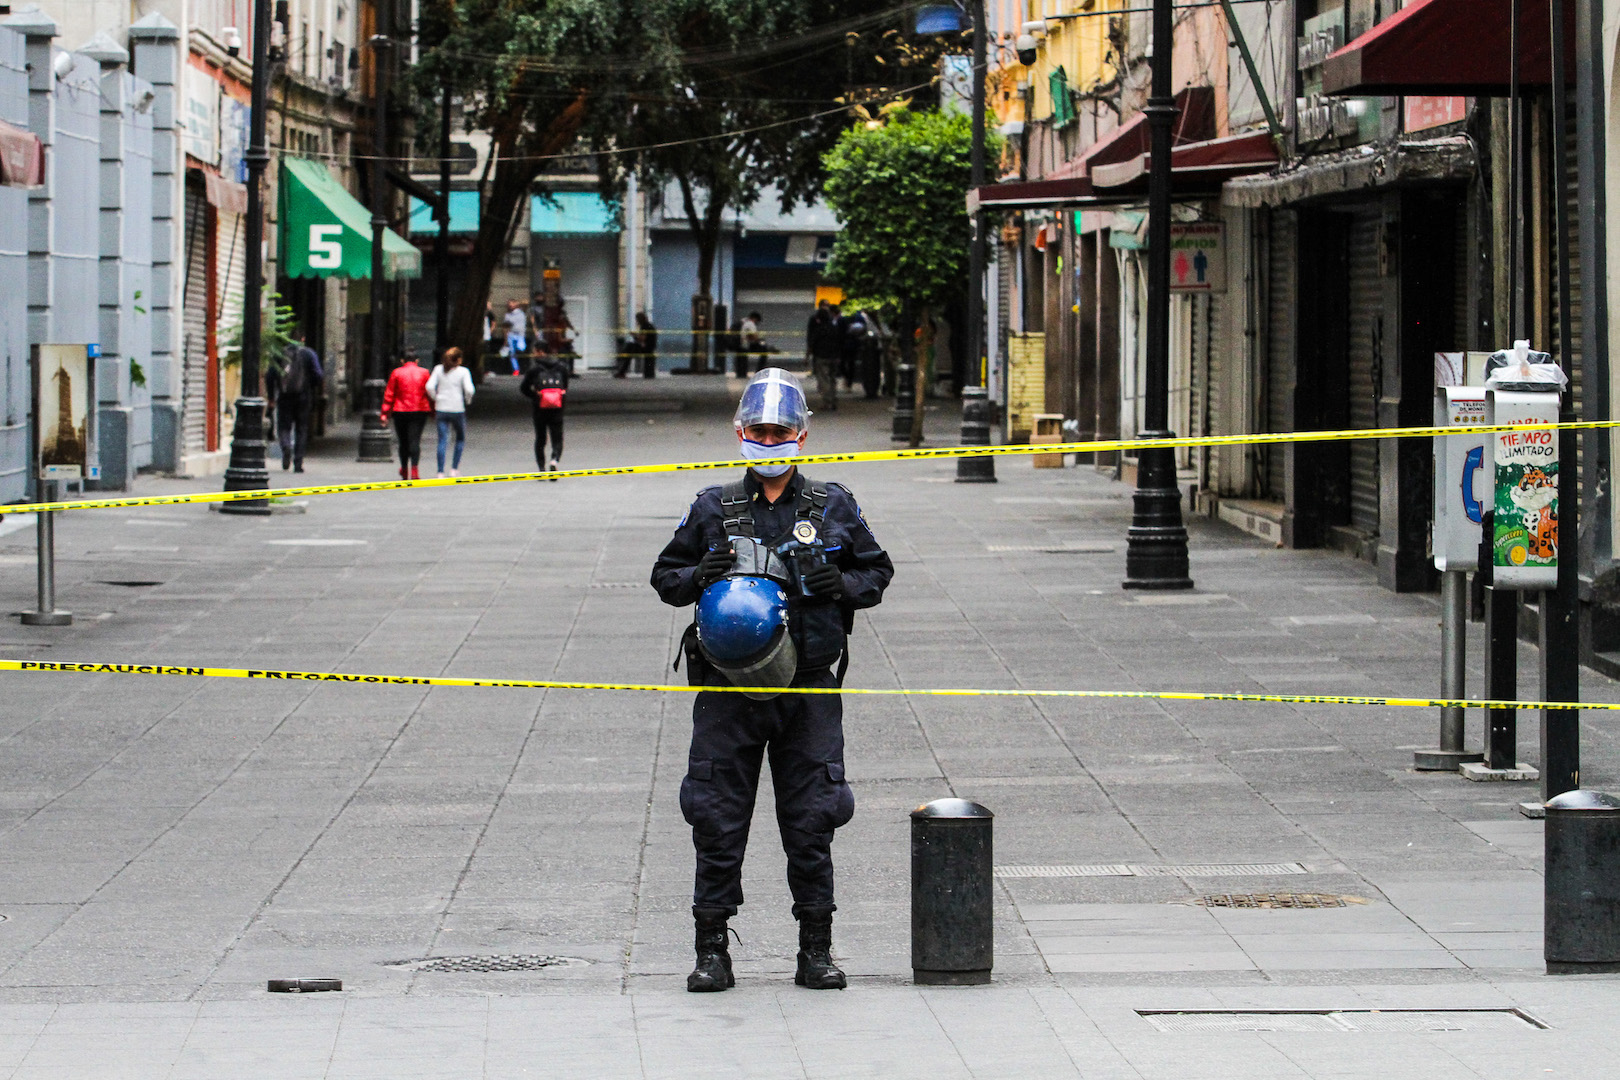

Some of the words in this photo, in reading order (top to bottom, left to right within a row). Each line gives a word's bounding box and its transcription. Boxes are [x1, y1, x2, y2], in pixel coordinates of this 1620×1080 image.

[309, 224, 343, 268] 5
[1500, 432, 1552, 446] TIEMPO
[21, 662, 204, 676] PRECAUCIÓN
